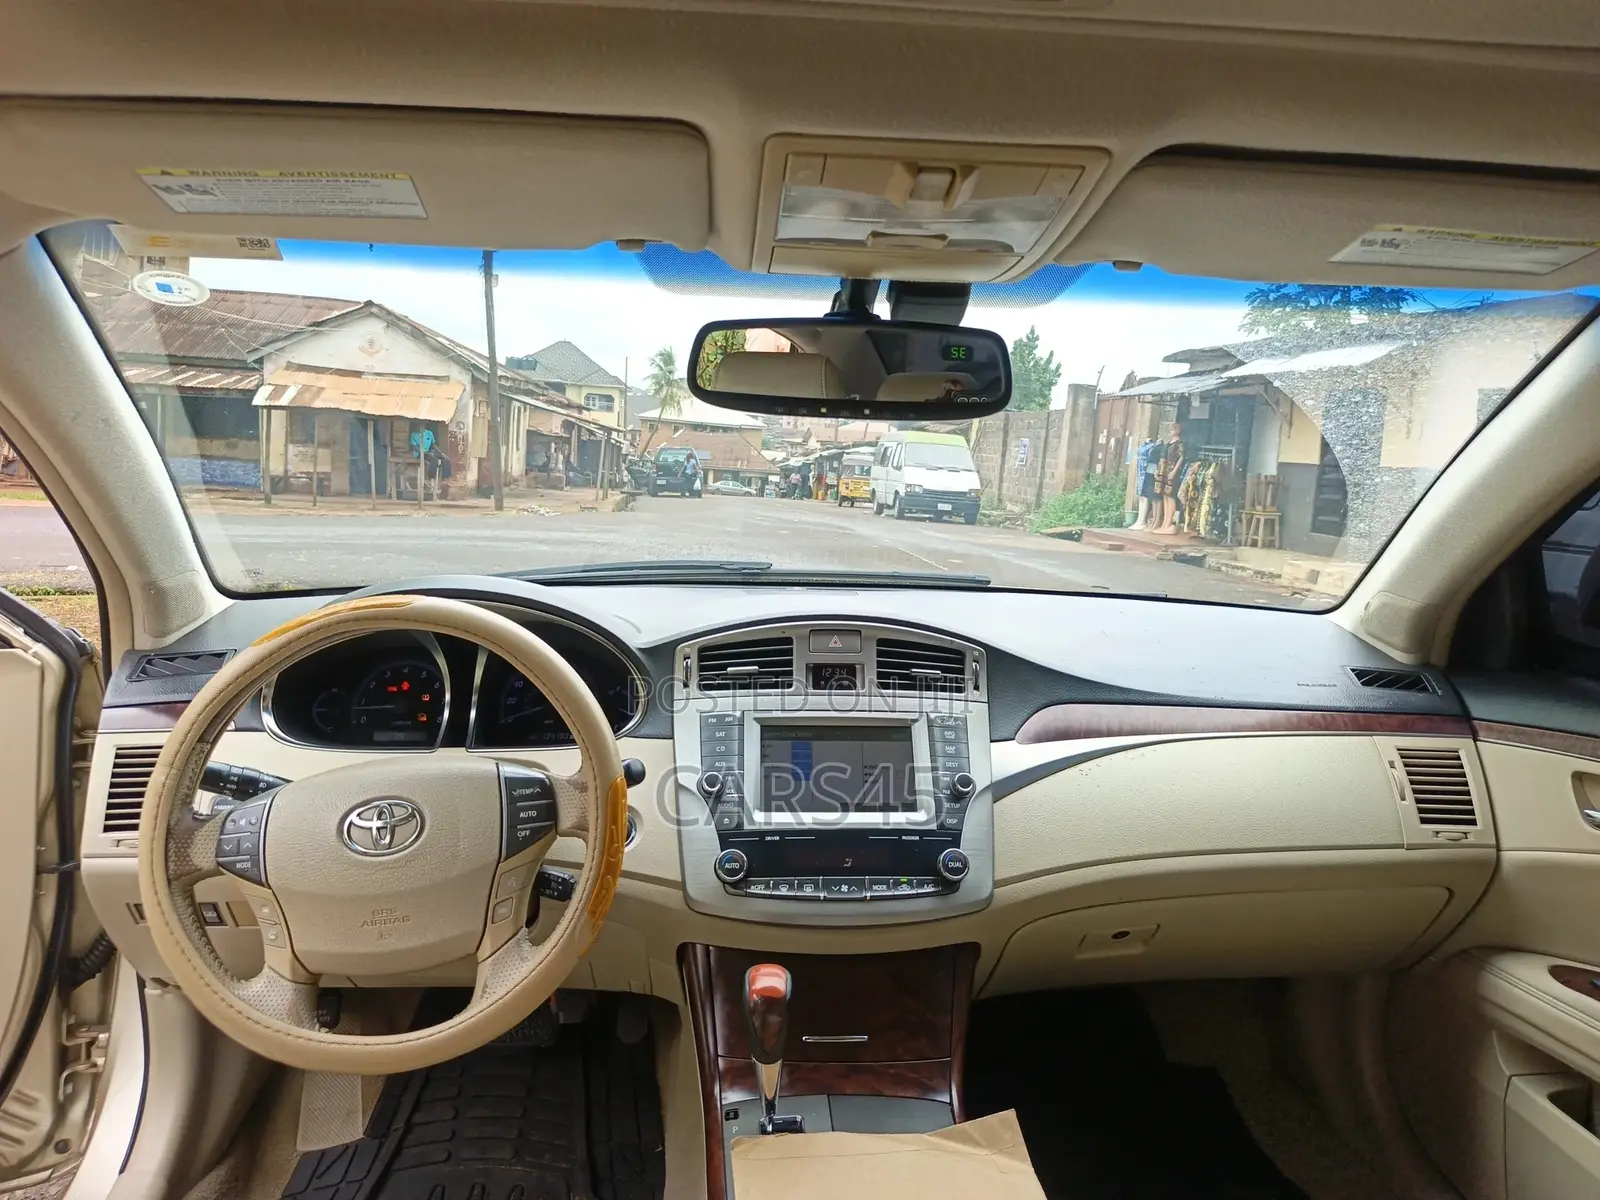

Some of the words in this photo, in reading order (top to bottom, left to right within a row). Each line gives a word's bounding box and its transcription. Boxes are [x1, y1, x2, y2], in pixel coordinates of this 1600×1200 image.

[279, 171, 397, 179] AVERTISSEMENT
[1416, 228, 1477, 239] WARNING
[519, 810, 538, 818] AUTO
[517, 829, 531, 837] OFF
[235, 861, 252, 869] MODE
[724, 861, 741, 869] AUTO
[372, 907, 399, 918] SRS
[361, 915, 412, 928] AIRBAG
[732, 1125, 739, 1133] P
